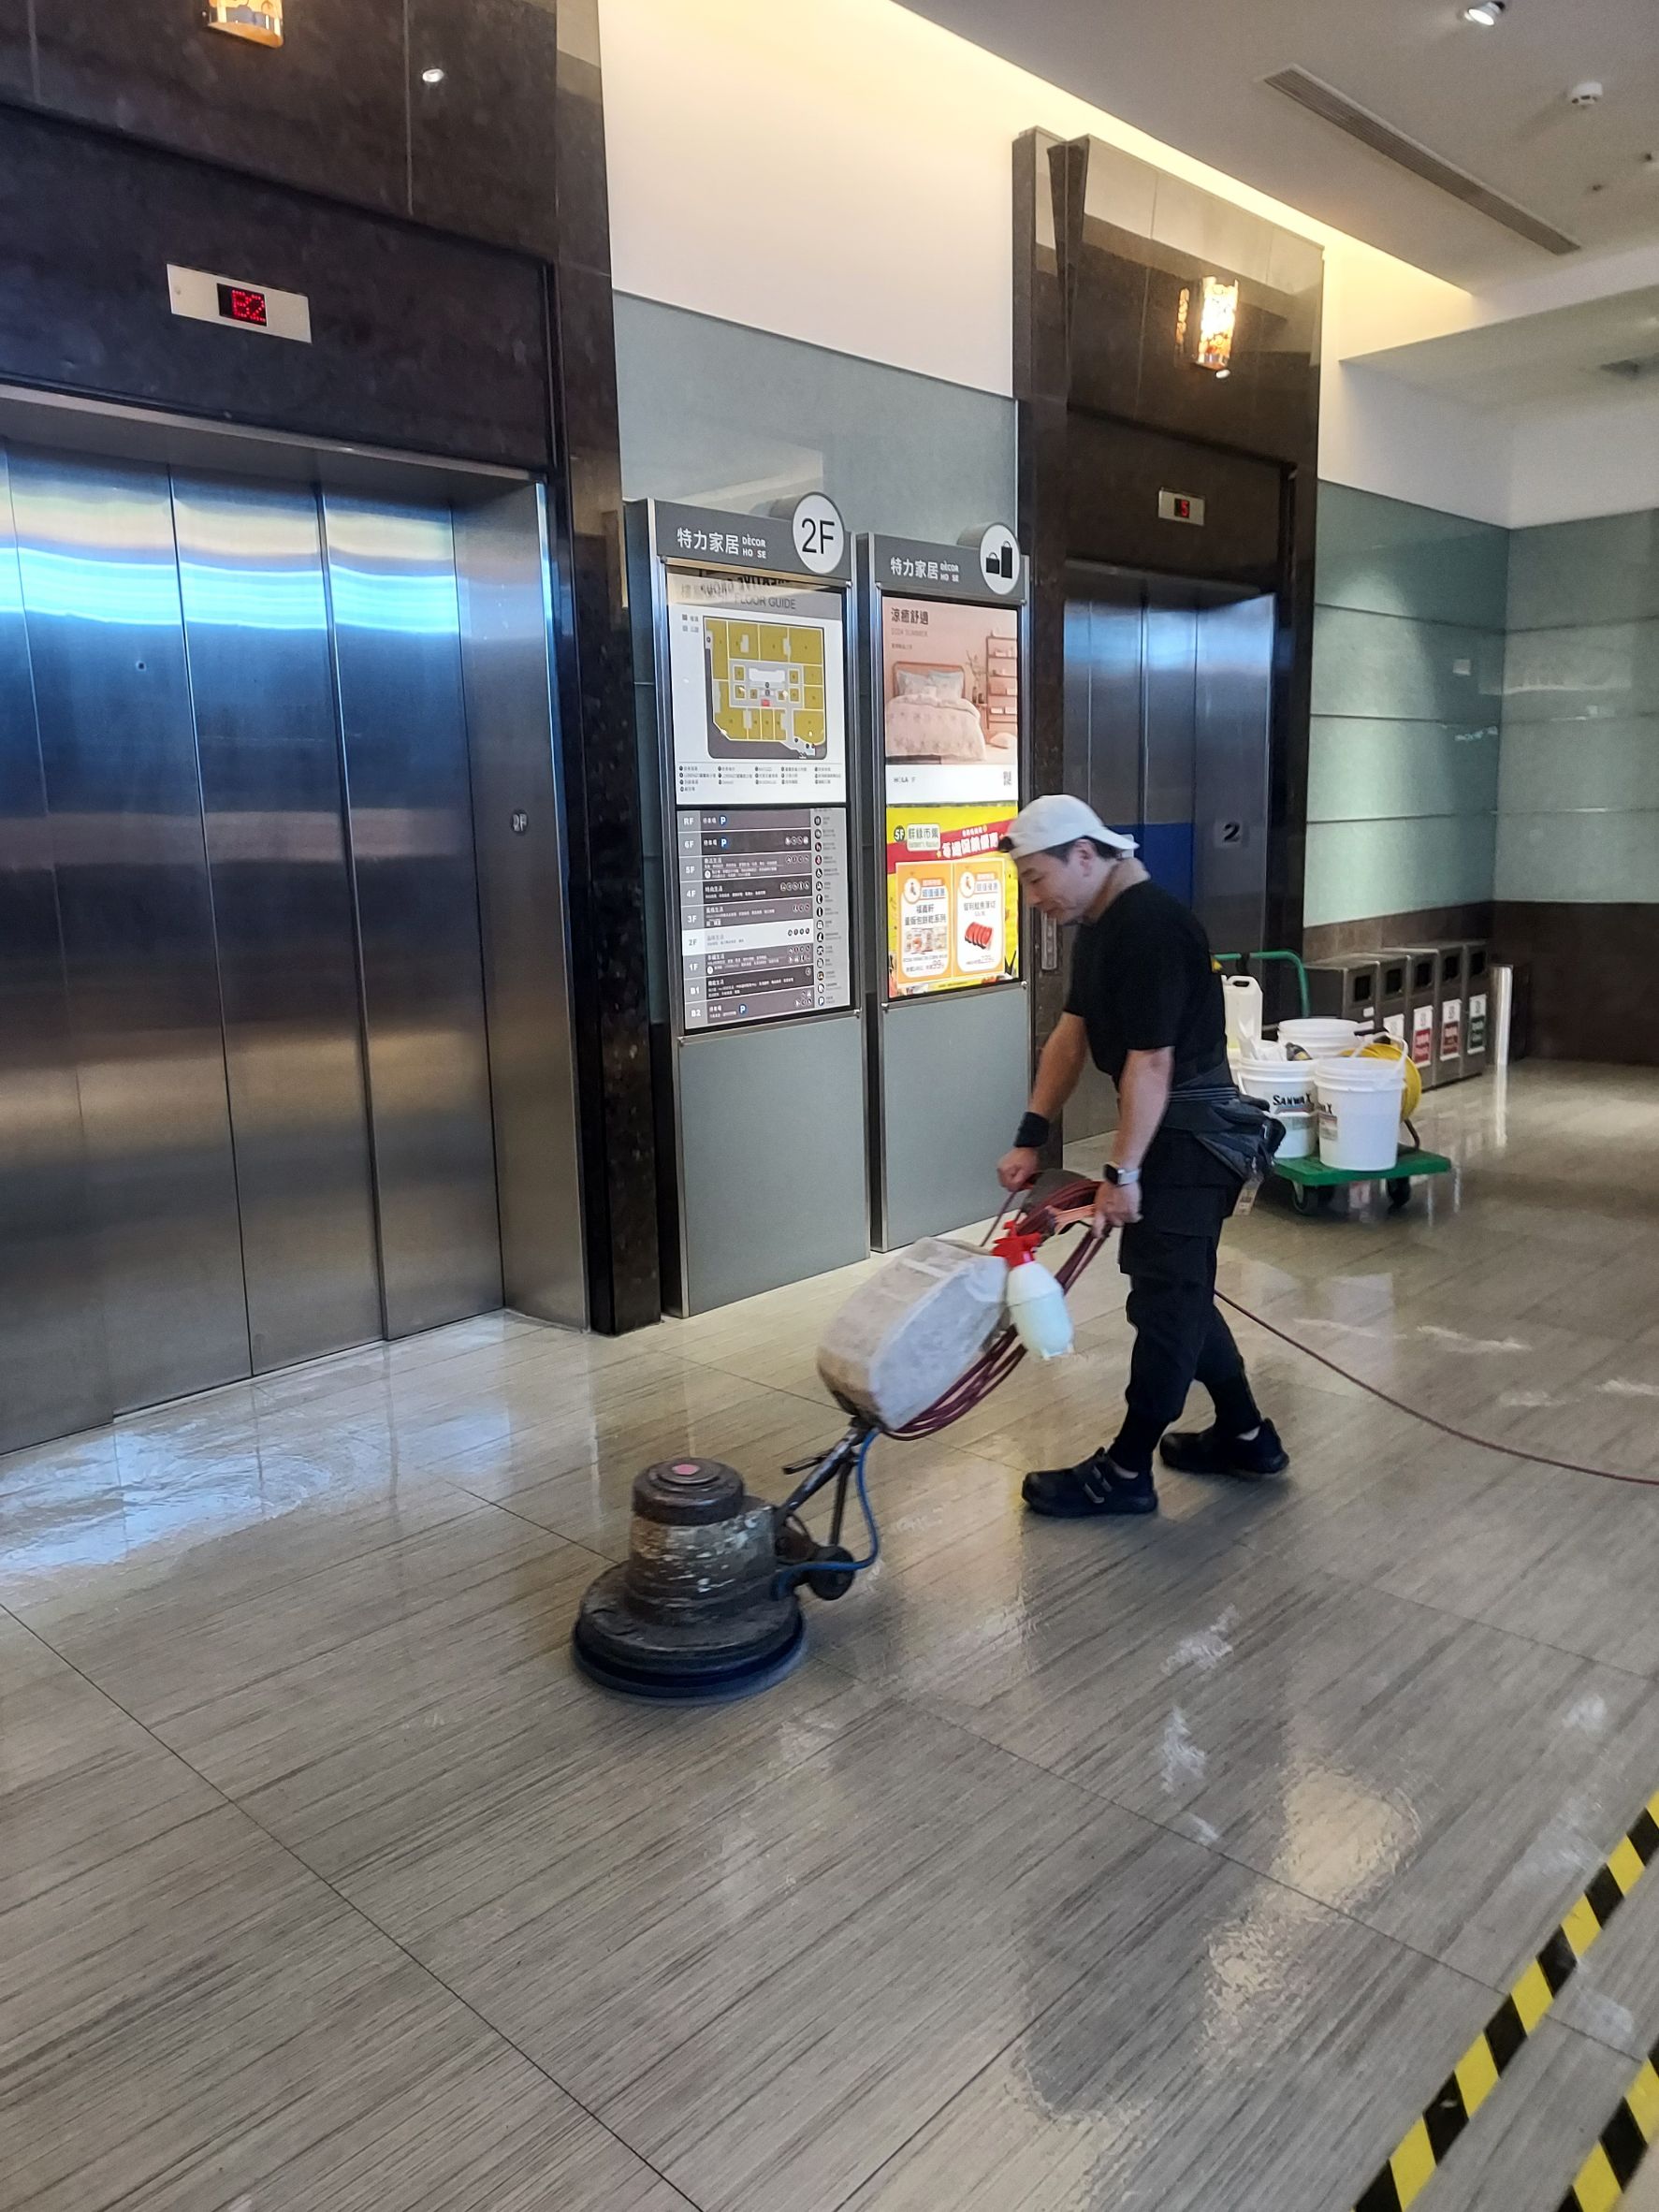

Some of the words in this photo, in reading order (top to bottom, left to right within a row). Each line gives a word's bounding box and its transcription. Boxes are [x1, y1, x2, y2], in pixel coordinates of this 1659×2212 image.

[231, 289, 267, 323] B2
[801, 517, 836, 555] 2F
[677, 527, 739, 556] 特力家居
[742, 549, 766, 560] HOSE
[890, 557, 939, 580] 特力家居
[767, 597, 797, 609] GUIDE
[683, 817, 694, 825] RF
[894, 828, 905, 841] 5F
[1224, 822, 1241, 842] 2
[684, 840, 694, 849] 6F
[685, 866, 695, 874] 5F
[686, 890, 696, 898] 4F
[687, 914, 697, 924] 3F
[689, 963, 698, 971] 1F
[690, 986, 700, 995] B1
[691, 1009, 702, 1017] B2
